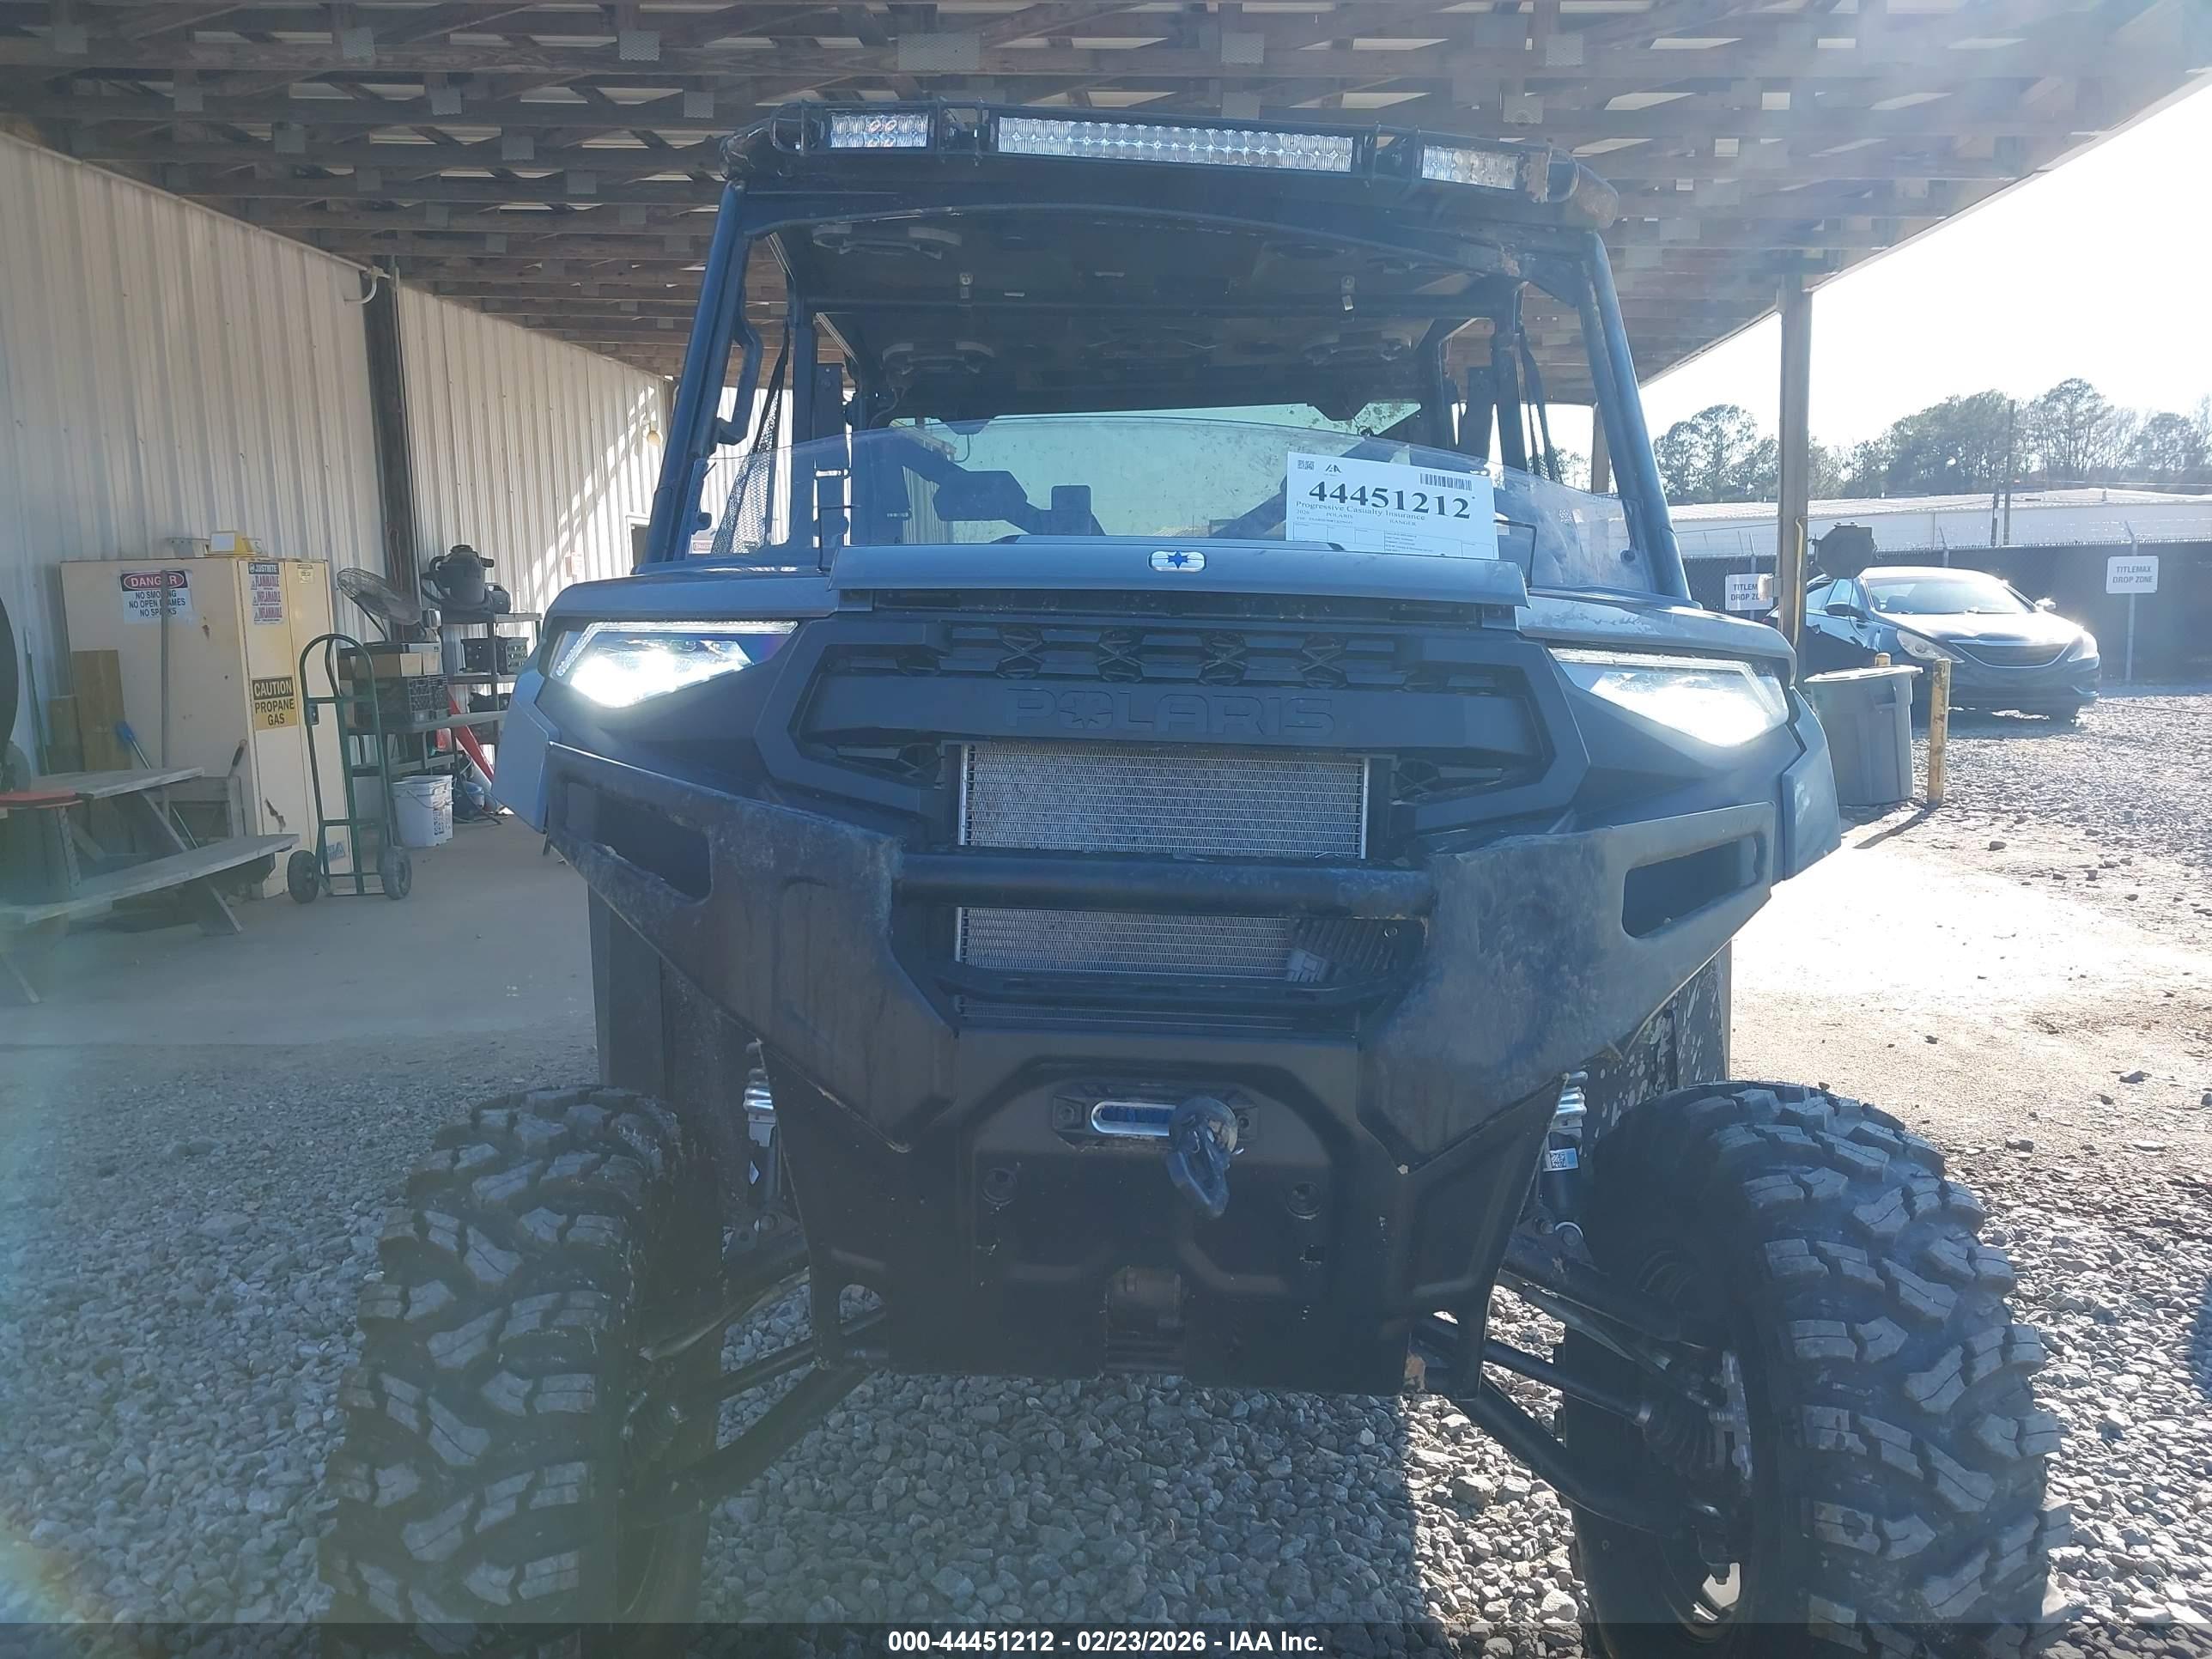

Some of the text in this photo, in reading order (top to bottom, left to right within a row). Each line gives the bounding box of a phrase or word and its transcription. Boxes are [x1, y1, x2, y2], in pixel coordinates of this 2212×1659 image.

[1309, 481, 1471, 520] 44451212
[1296, 501, 1426, 521] Progressive Casualty Insurance
[131, 574, 177, 587] DANGR
[140, 599, 158, 608] OPEN
[253, 679, 292, 697] CAUTION
[254, 698, 295, 714] PROPANE
[1006, 688, 1336, 737] POLARIS
[267, 713, 285, 726] GAS
